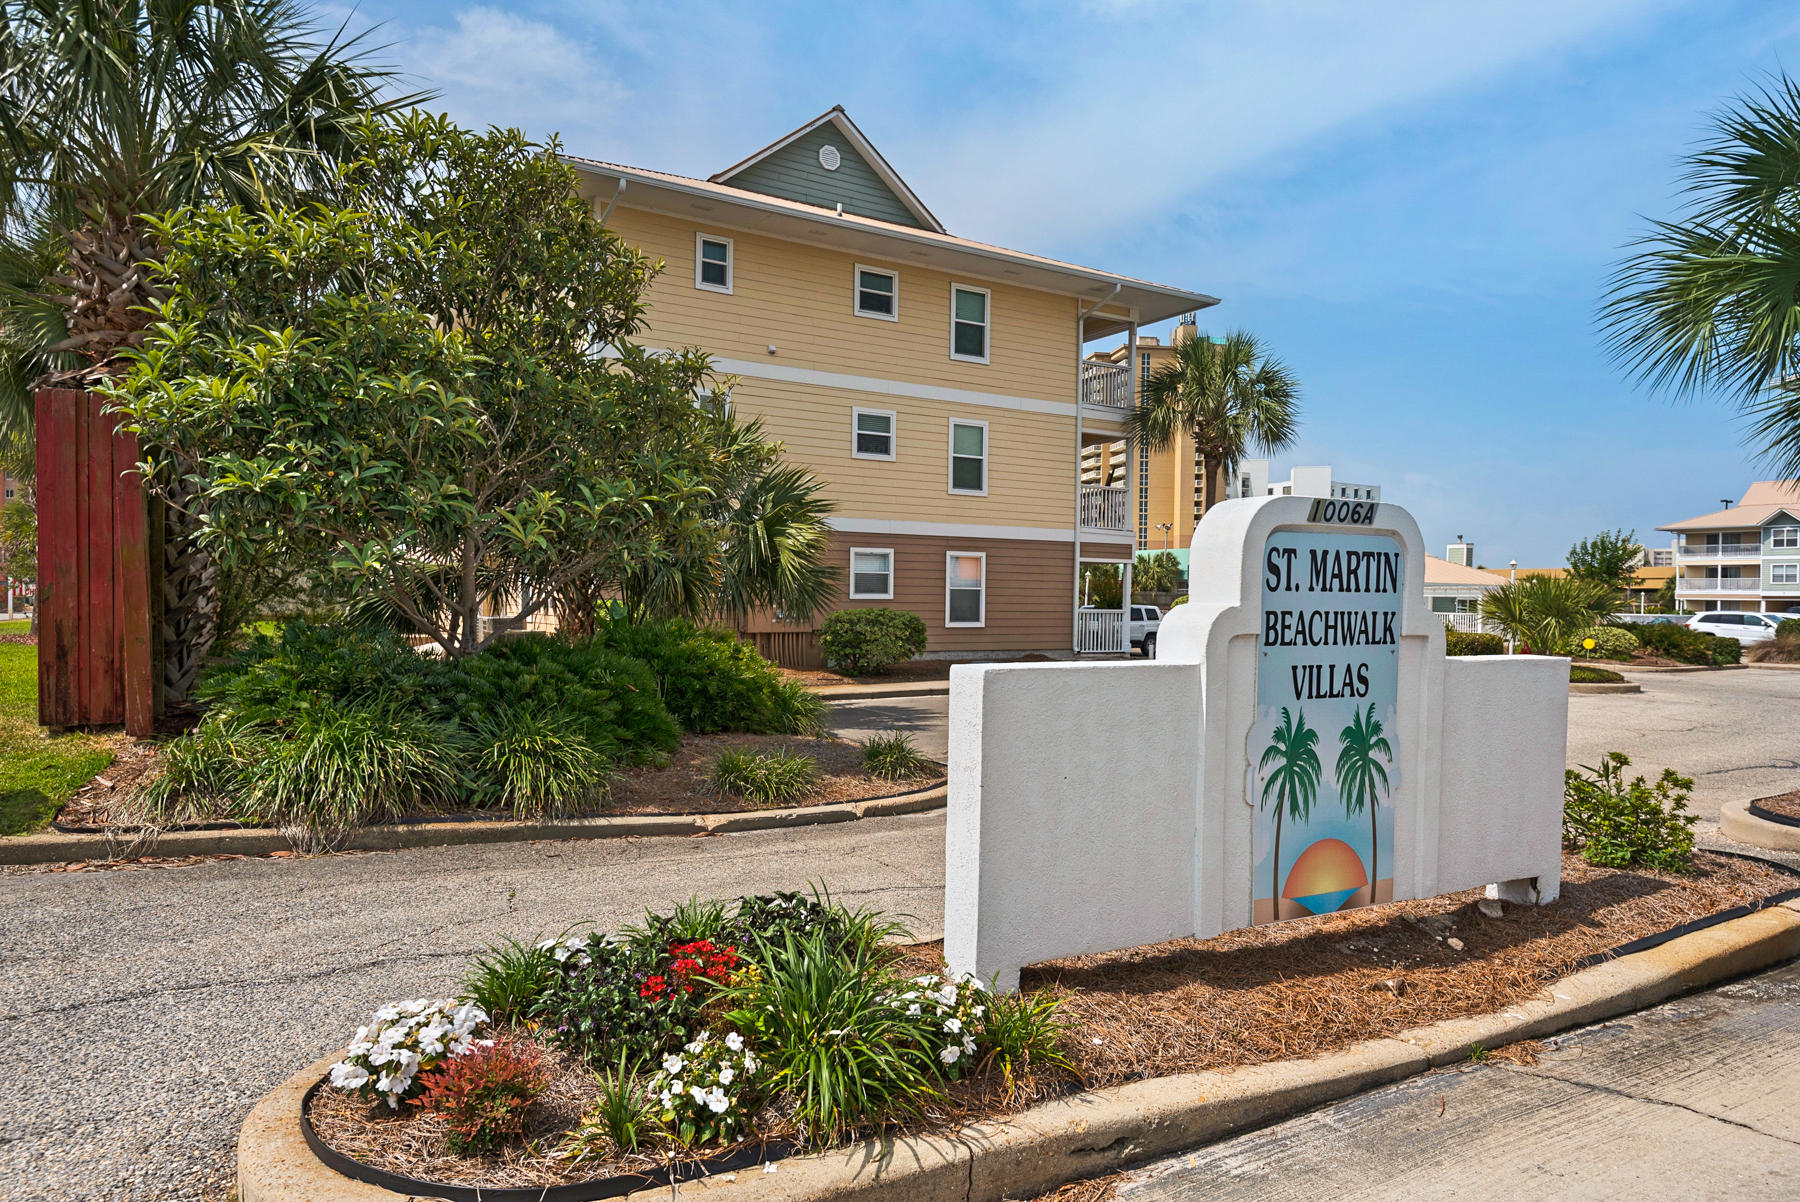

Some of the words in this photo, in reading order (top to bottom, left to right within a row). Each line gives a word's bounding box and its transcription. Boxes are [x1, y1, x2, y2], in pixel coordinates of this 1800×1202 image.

[1265, 546, 1300, 593] ST.
[1308, 549, 1400, 594] MARTIN
[1263, 609, 1397, 647] BEACHWALK
[1291, 662, 1370, 701] VILLAS
